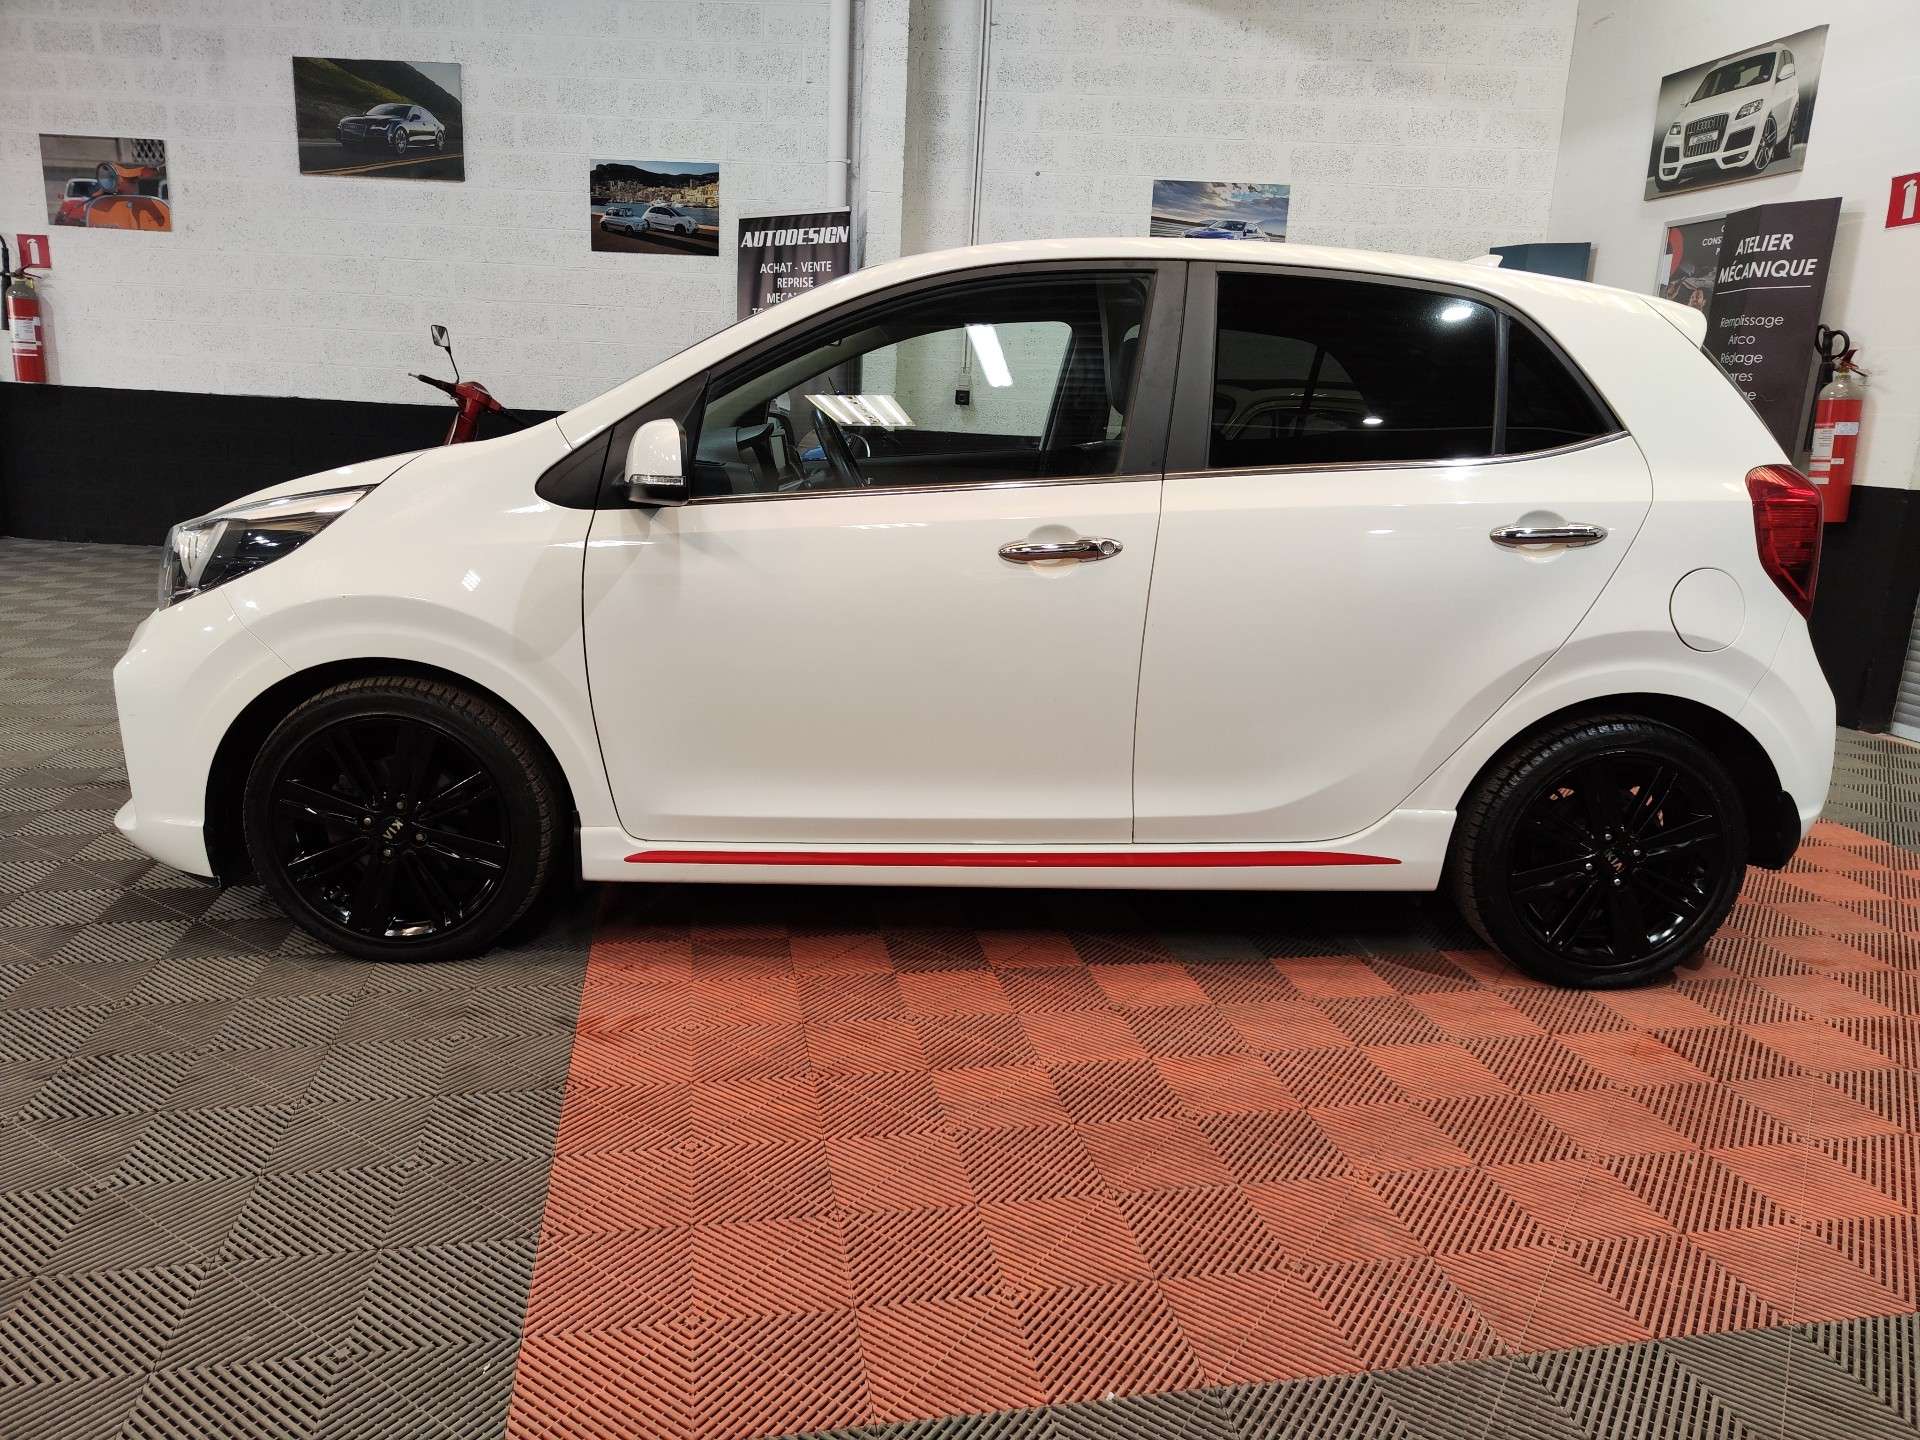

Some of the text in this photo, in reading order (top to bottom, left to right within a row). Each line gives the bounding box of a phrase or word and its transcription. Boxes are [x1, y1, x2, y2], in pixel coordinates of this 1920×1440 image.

[741, 226, 850, 248] AUTODESIGN
[1735, 234, 1794, 256] ATELIER
[760, 262, 792, 274] ACHAT
[801, 260, 832, 273] VENTE
[1718, 258, 1818, 284] MÉCANIQUE
[777, 276, 814, 289] REPRISE
[1720, 314, 1784, 328] Remplissage
[1728, 334, 1756, 345] Airco
[1720, 352, 1763, 366] Réglage
[382, 819, 404, 839] KIA
